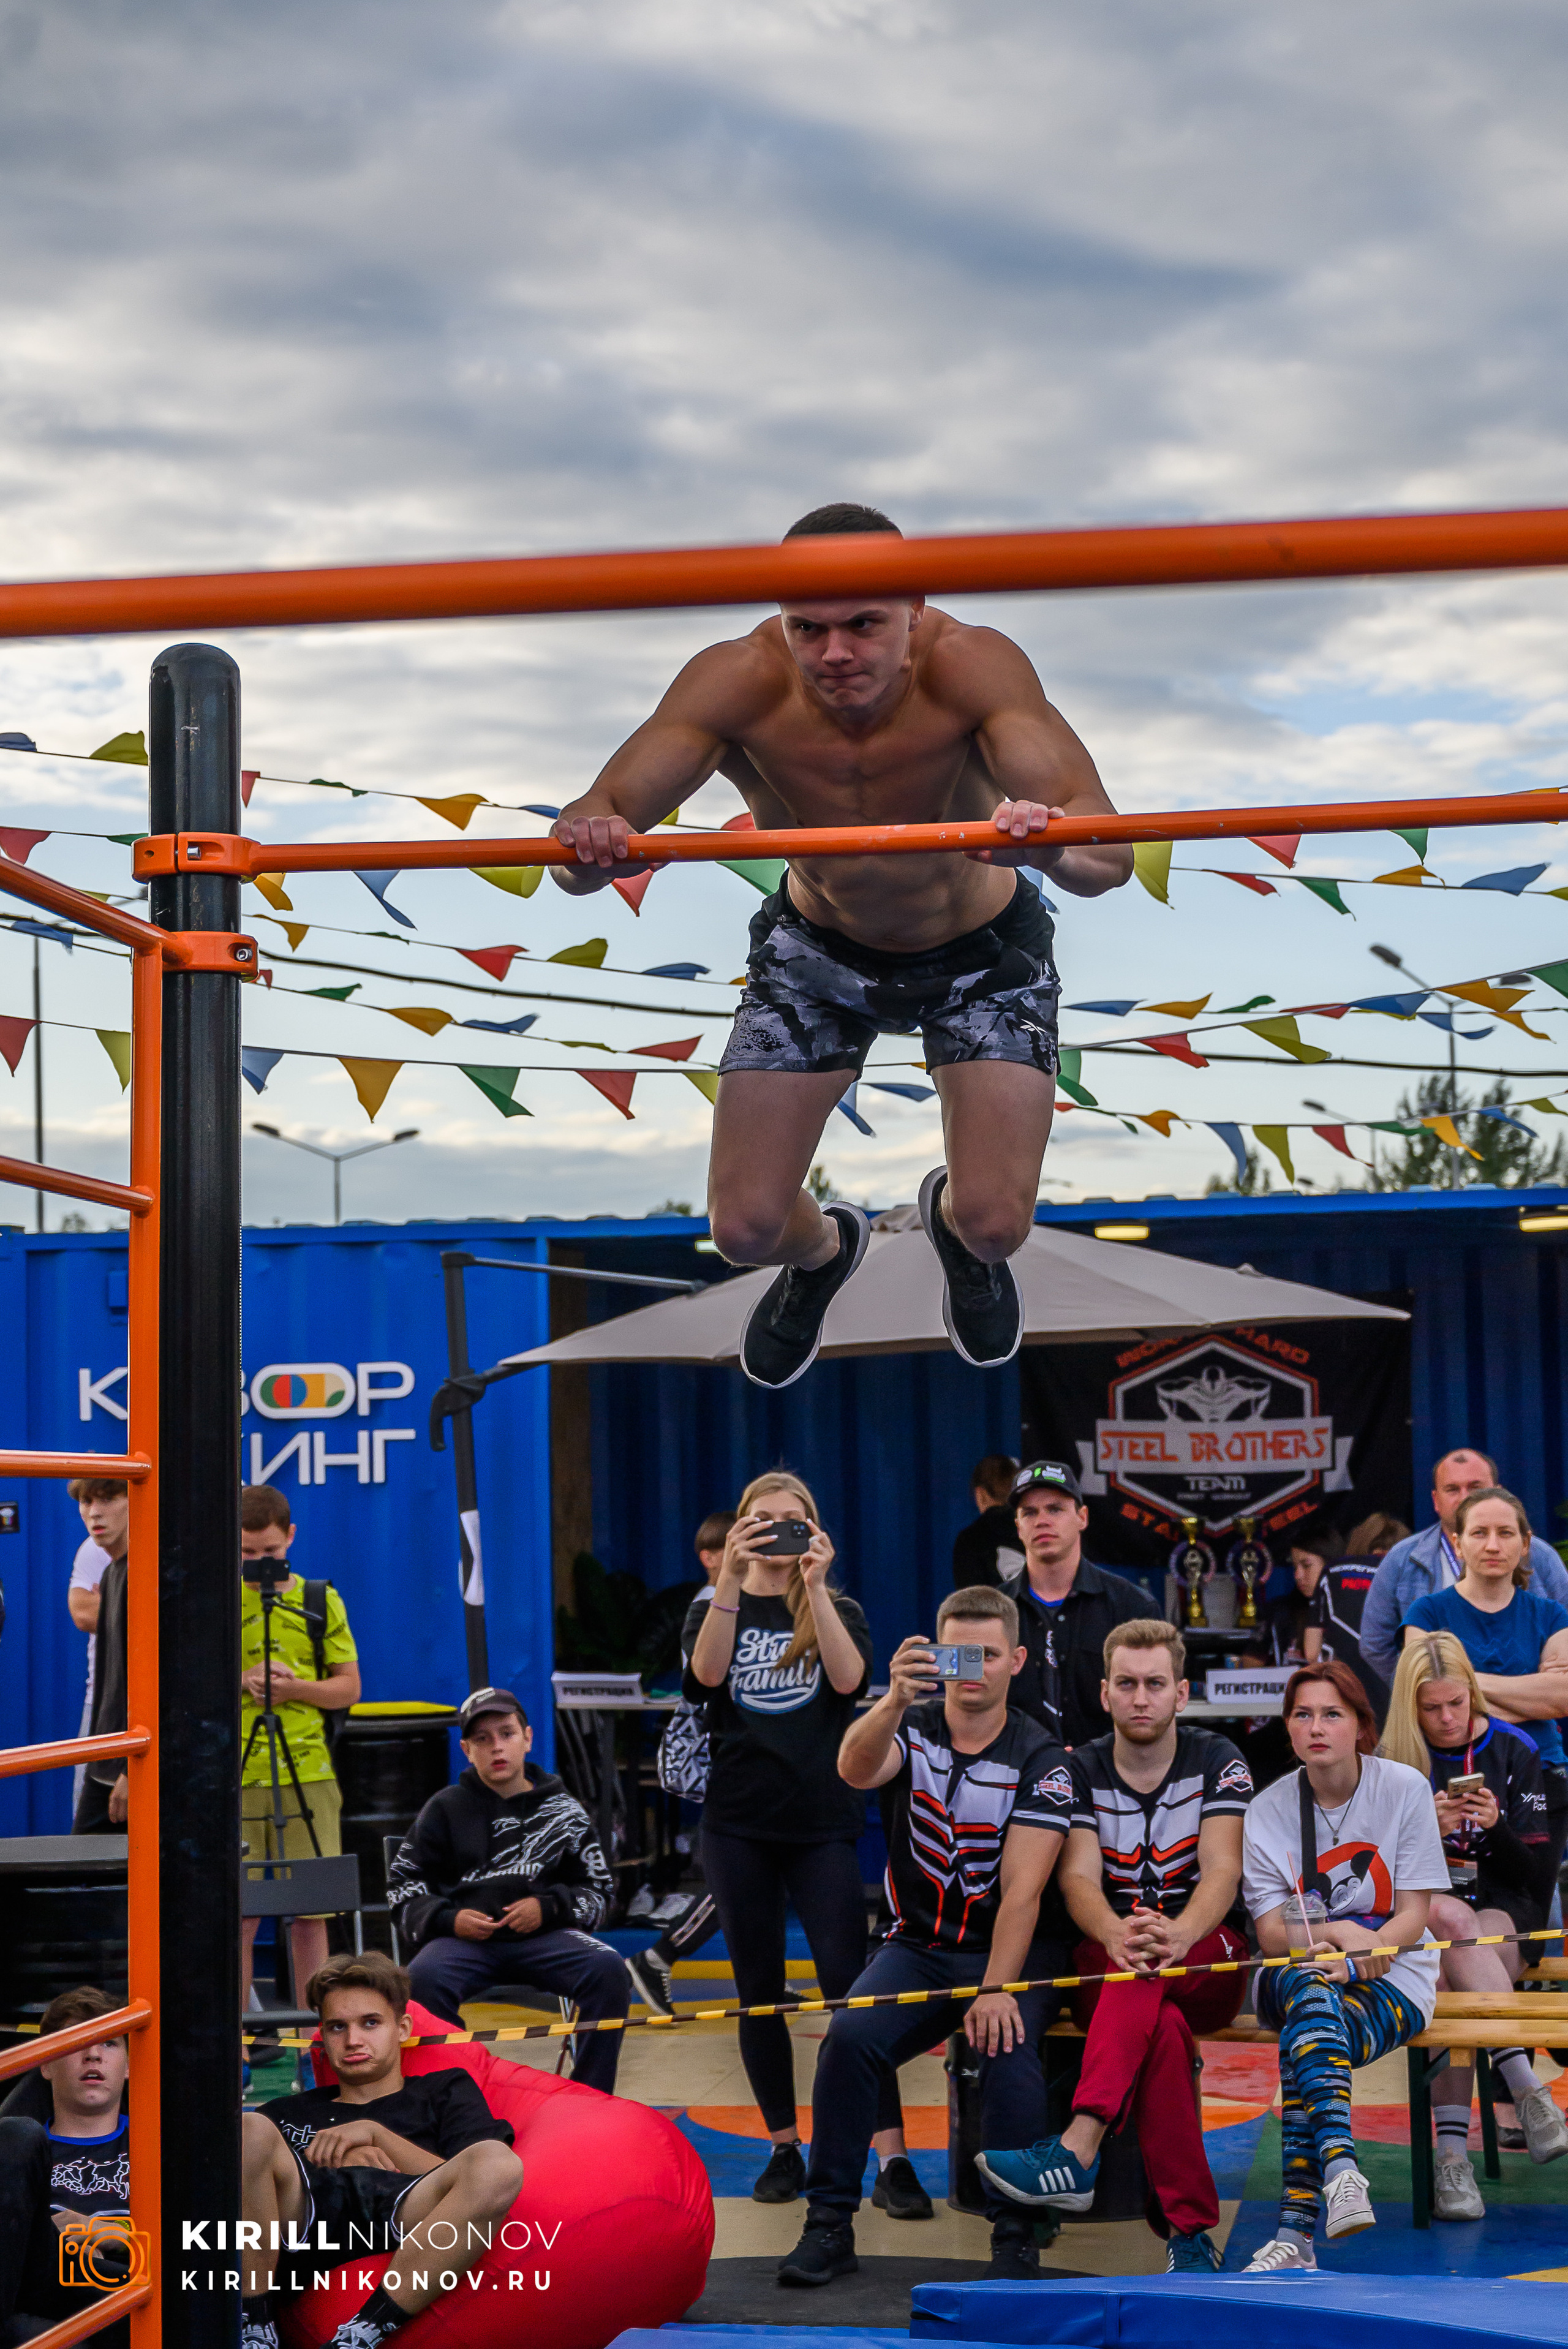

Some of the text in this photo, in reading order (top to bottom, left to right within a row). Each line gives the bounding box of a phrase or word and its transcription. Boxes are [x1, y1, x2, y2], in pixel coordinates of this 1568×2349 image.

[241, 1428, 417, 1486] ИНГ
[1100, 1428, 1330, 1462] STEEL BROTHERS
[1184, 1475, 1246, 1491] TEAM
[1214, 1682, 1286, 1695] РЕГИСТРАЦИ
